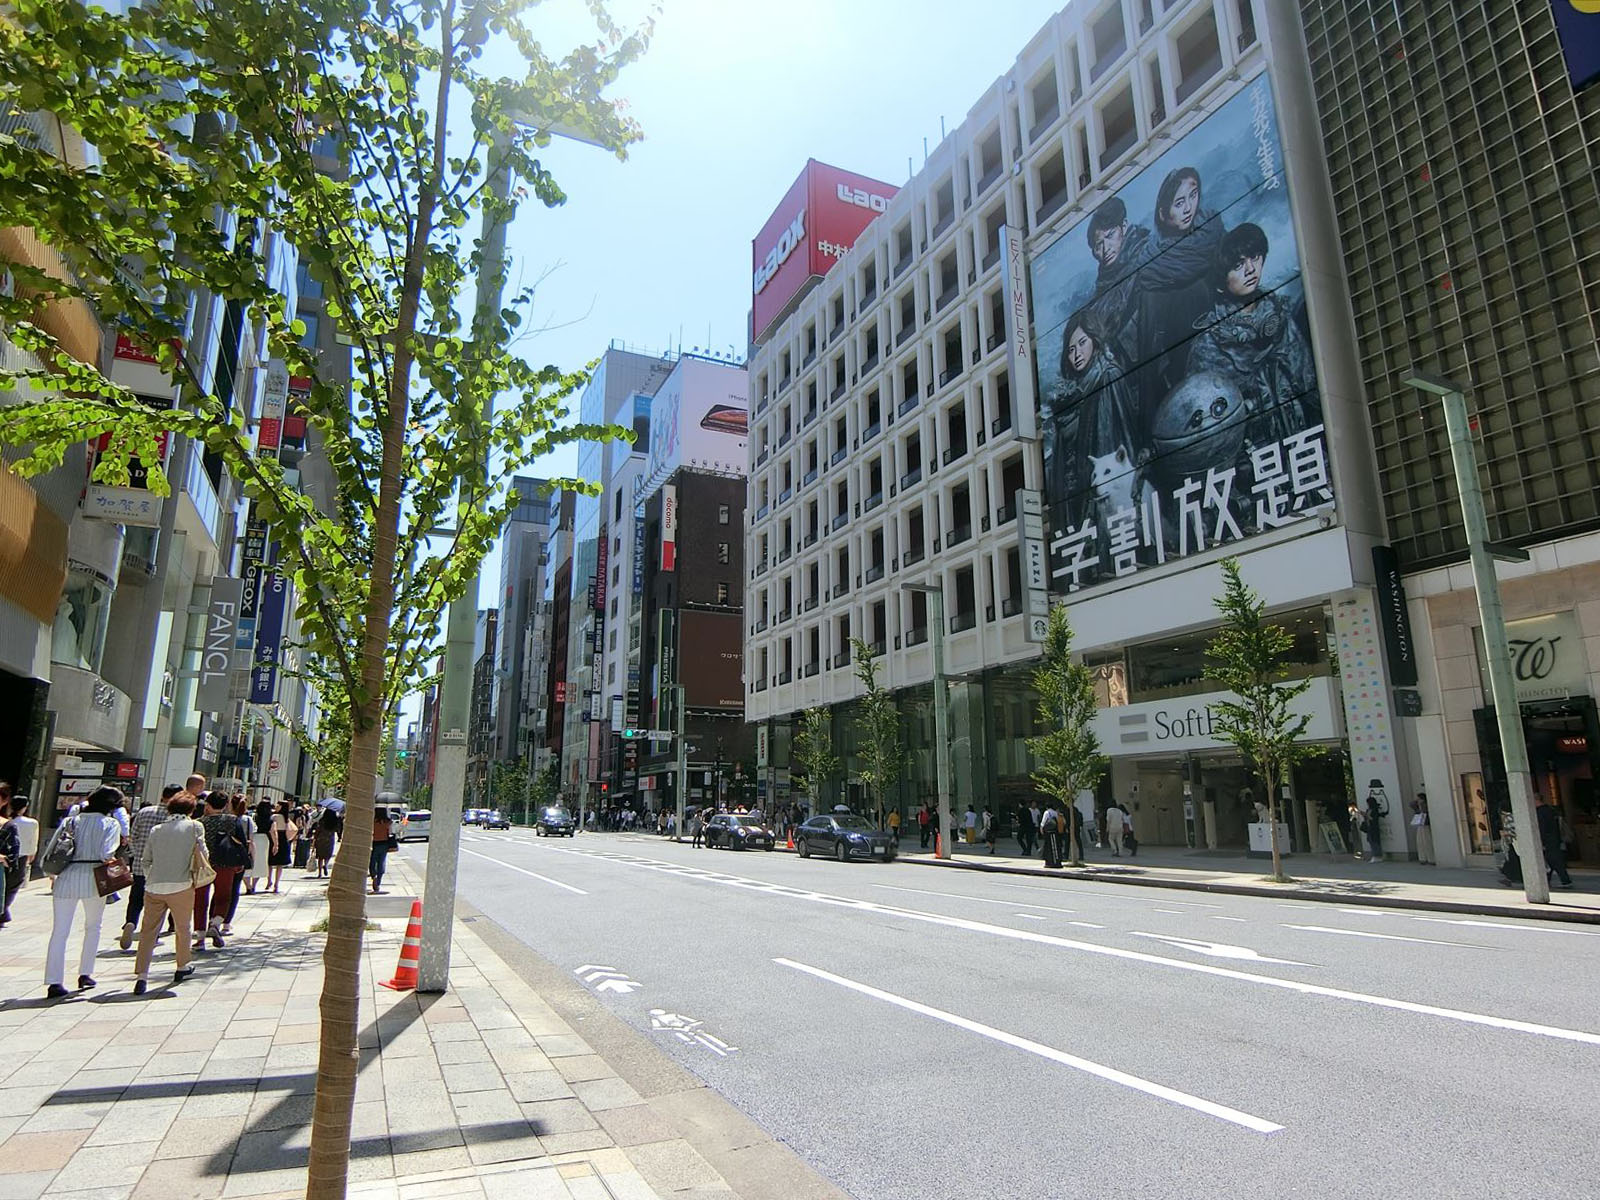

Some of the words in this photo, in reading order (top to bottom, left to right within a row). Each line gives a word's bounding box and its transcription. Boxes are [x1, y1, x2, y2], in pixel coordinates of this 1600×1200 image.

[665, 497, 673, 529] docomo
[1050, 423, 1335, 592] 学割放題
[242, 565, 257, 612] GEOX
[1031, 544, 1041, 584] PLAZA
[202, 600, 236, 686] FANCL
[1389, 570, 1409, 662] WASHINGTON
